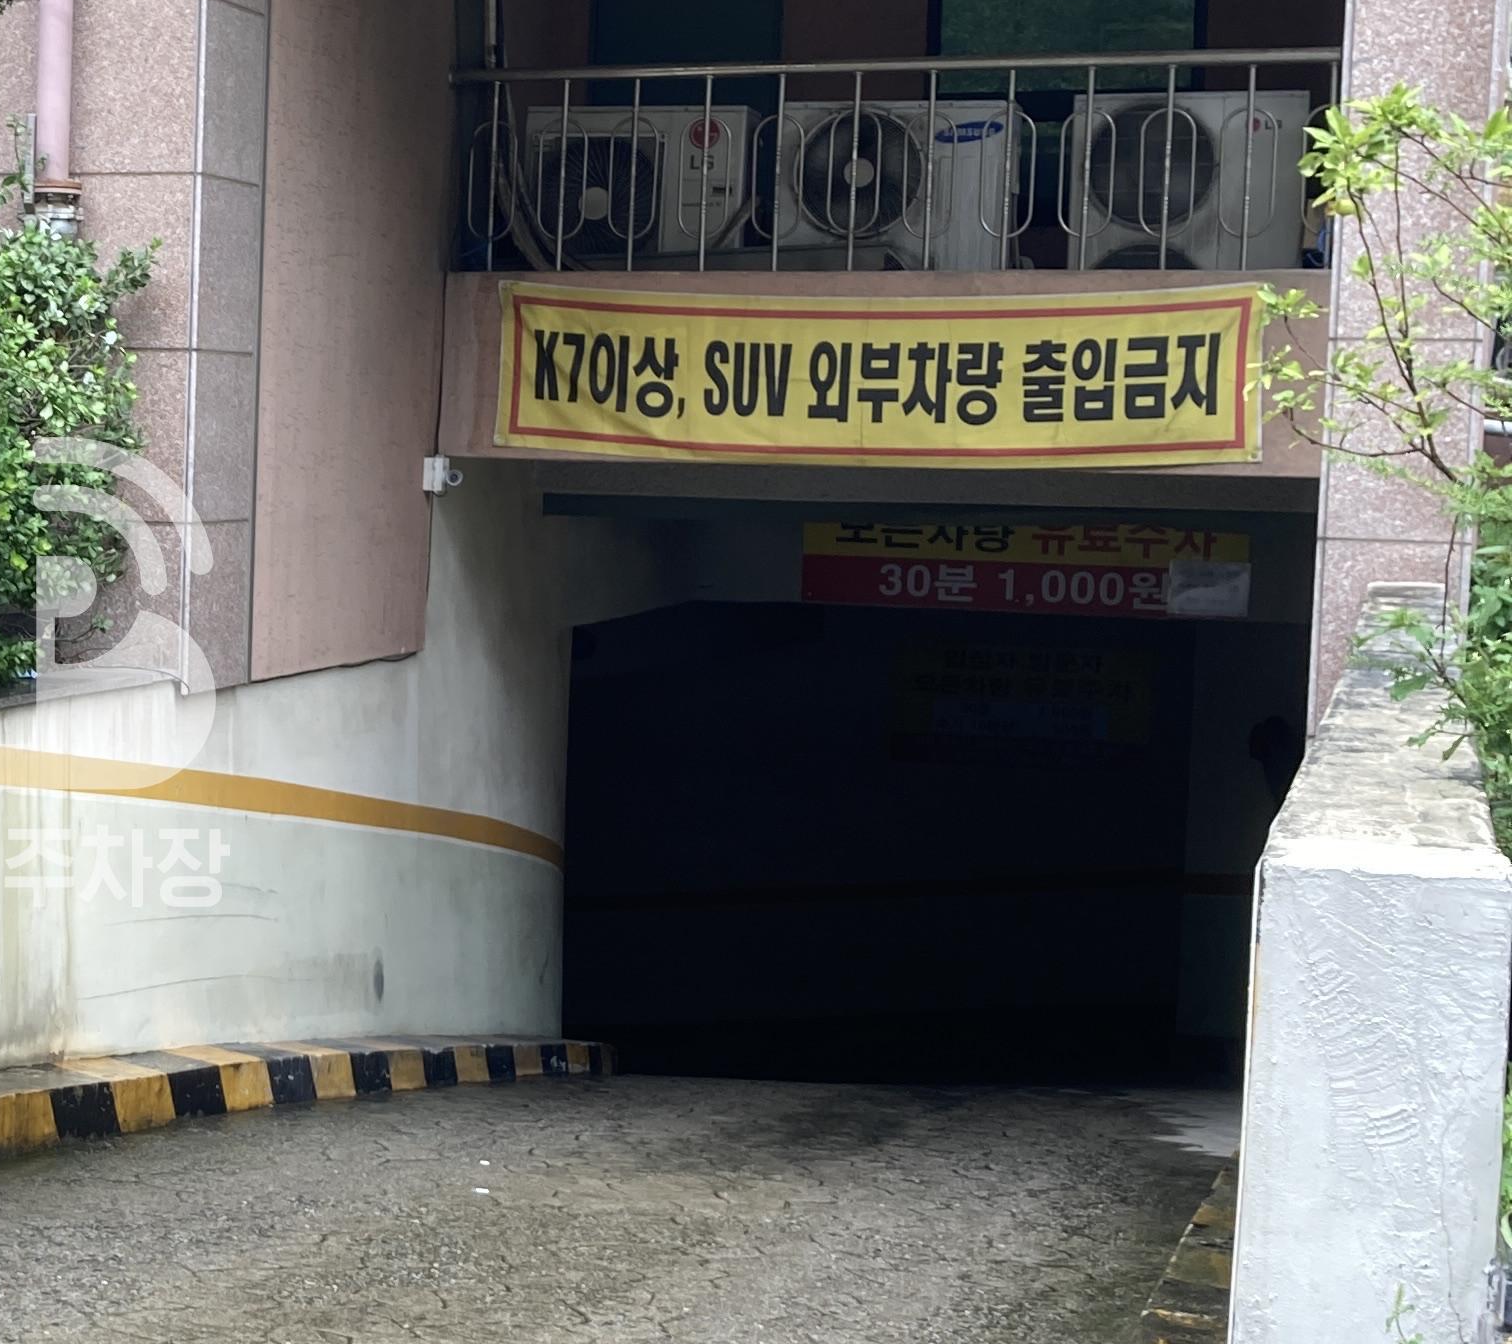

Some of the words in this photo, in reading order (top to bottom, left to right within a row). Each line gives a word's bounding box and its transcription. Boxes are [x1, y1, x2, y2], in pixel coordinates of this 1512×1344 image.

[534, 329, 685, 419] K7이상,
[703, 340, 793, 417] SUV
[807, 340, 1004, 426] 외부차량
[1022, 332, 1222, 423] 출입금지
[878, 563, 978, 603] 30분
[997, 567, 1172, 611] 1,000원
